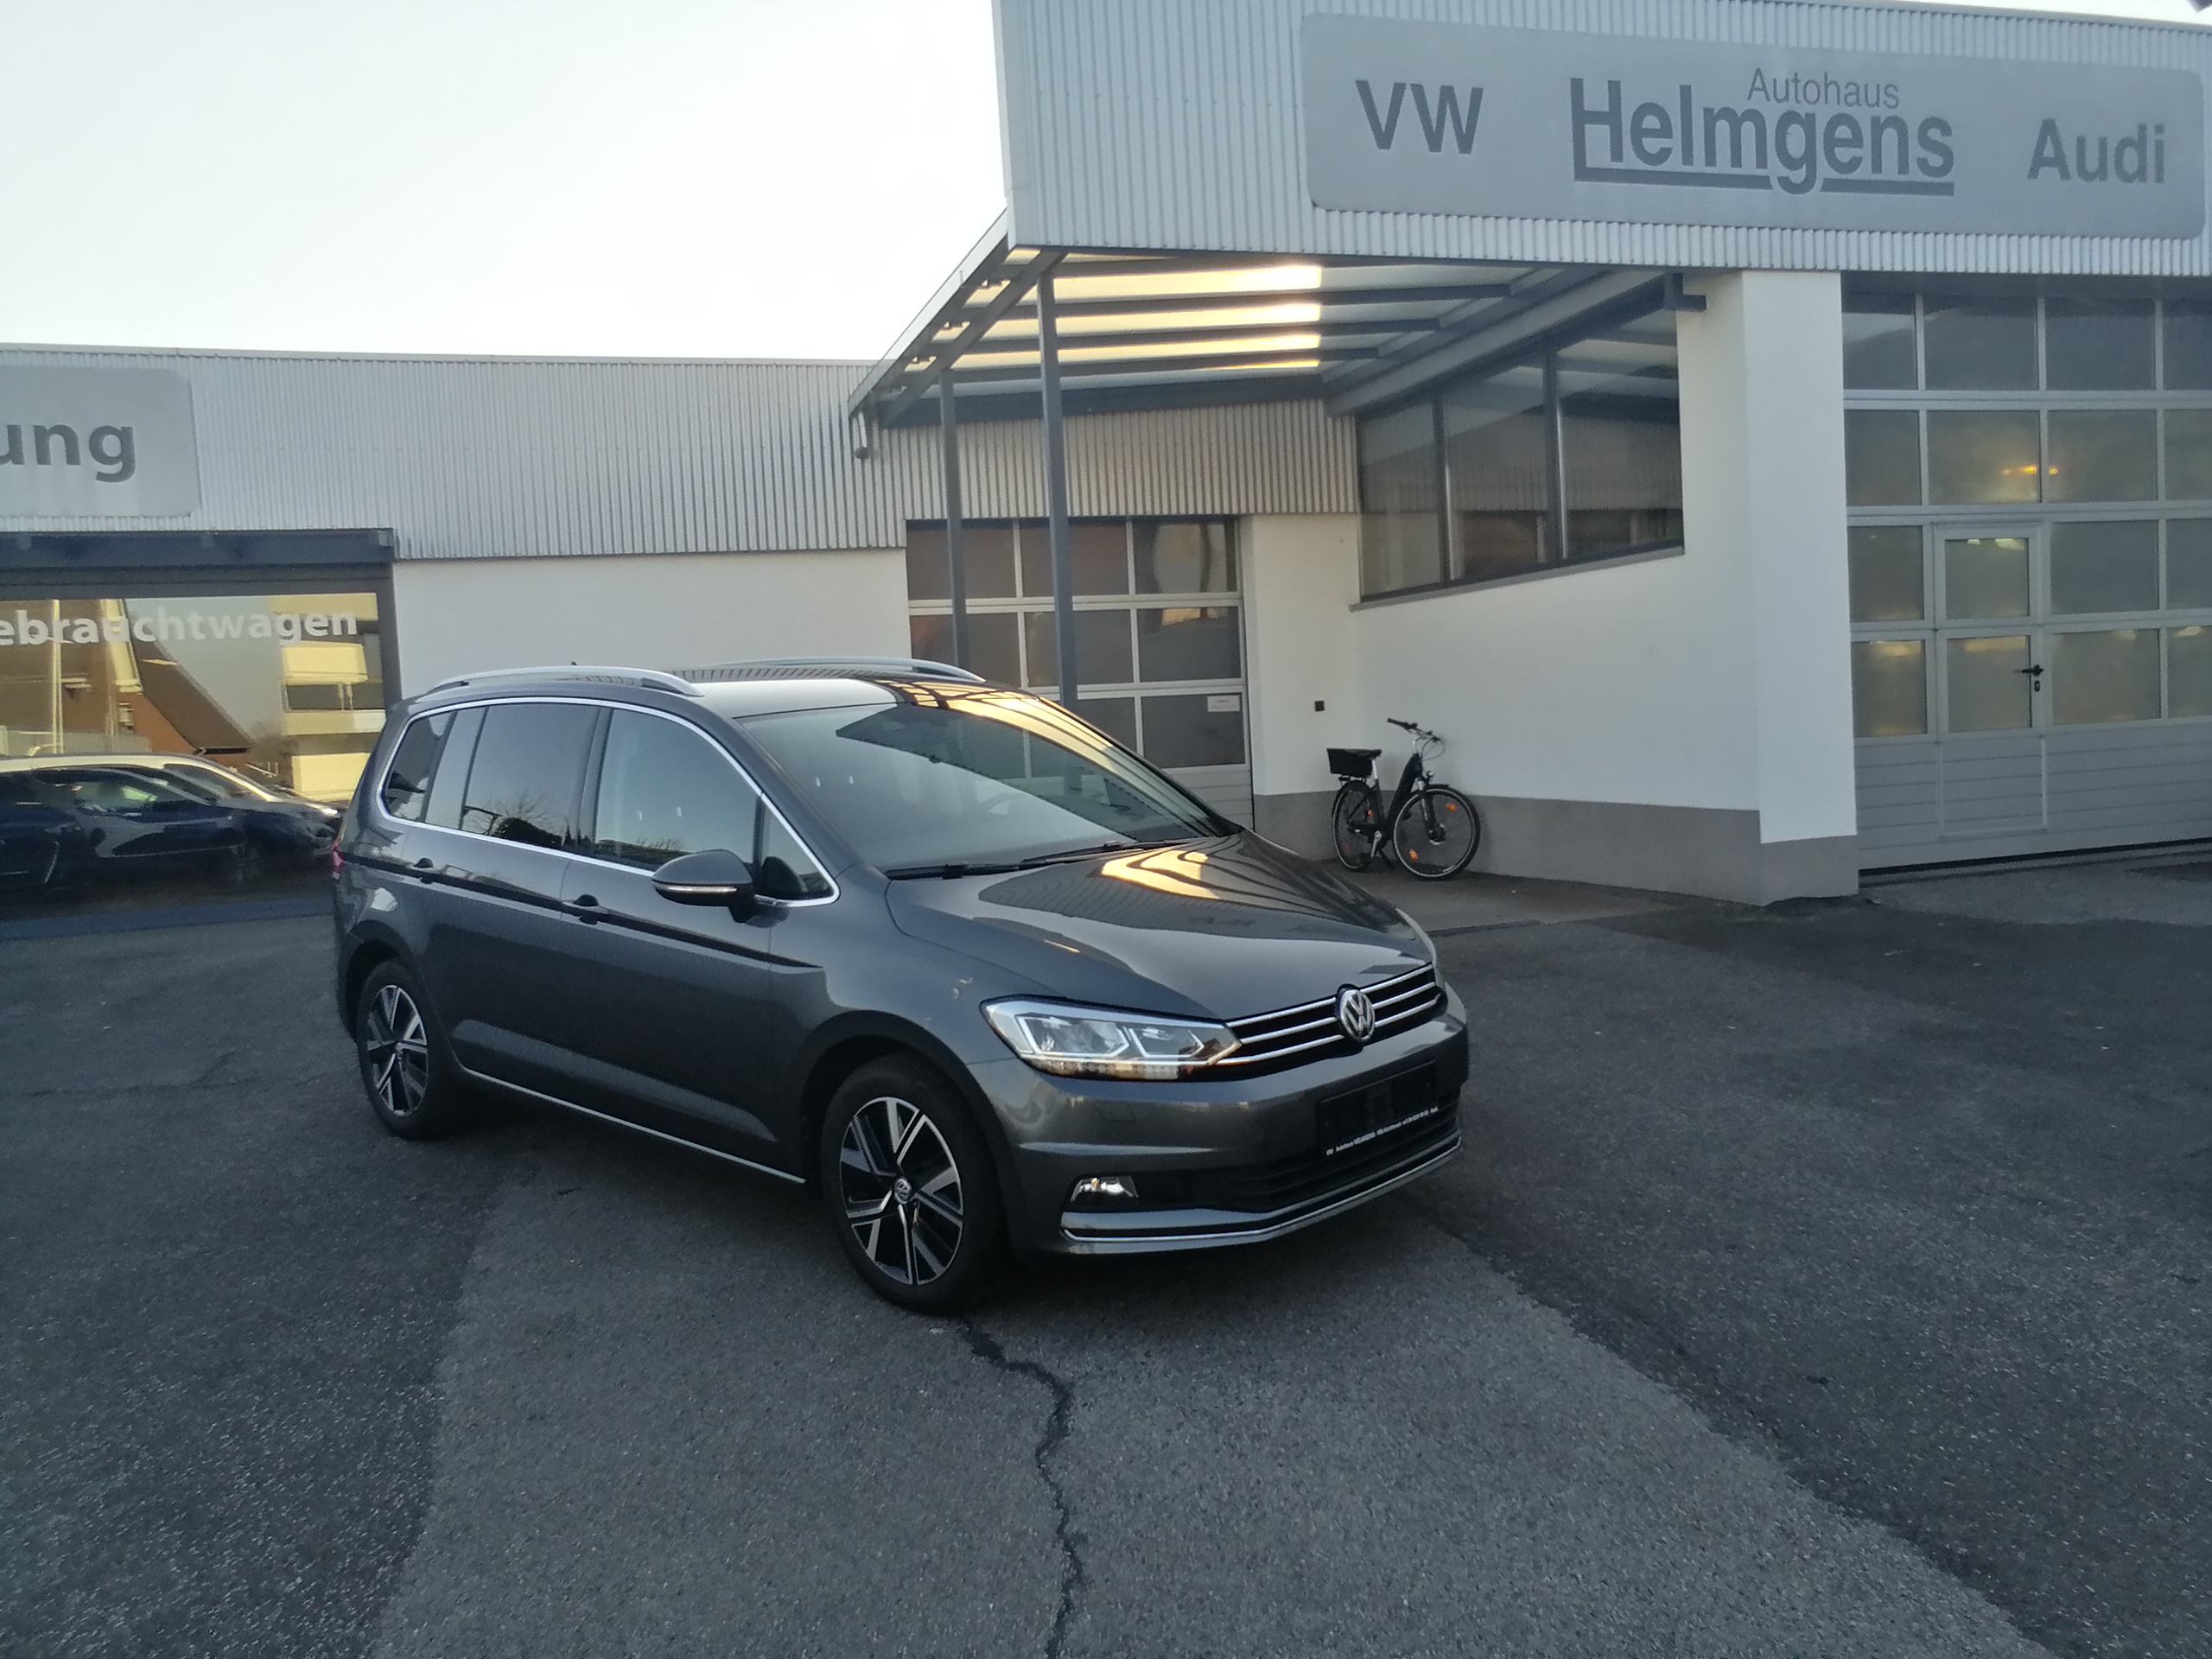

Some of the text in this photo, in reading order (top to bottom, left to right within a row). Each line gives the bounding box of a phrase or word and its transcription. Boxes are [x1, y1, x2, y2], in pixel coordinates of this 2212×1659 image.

[1355, 79, 1484, 155] VW
[1747, 67, 1900, 109] Autohaus
[1570, 77, 1955, 195] Helmgens
[2026, 118, 2165, 184] Audi
